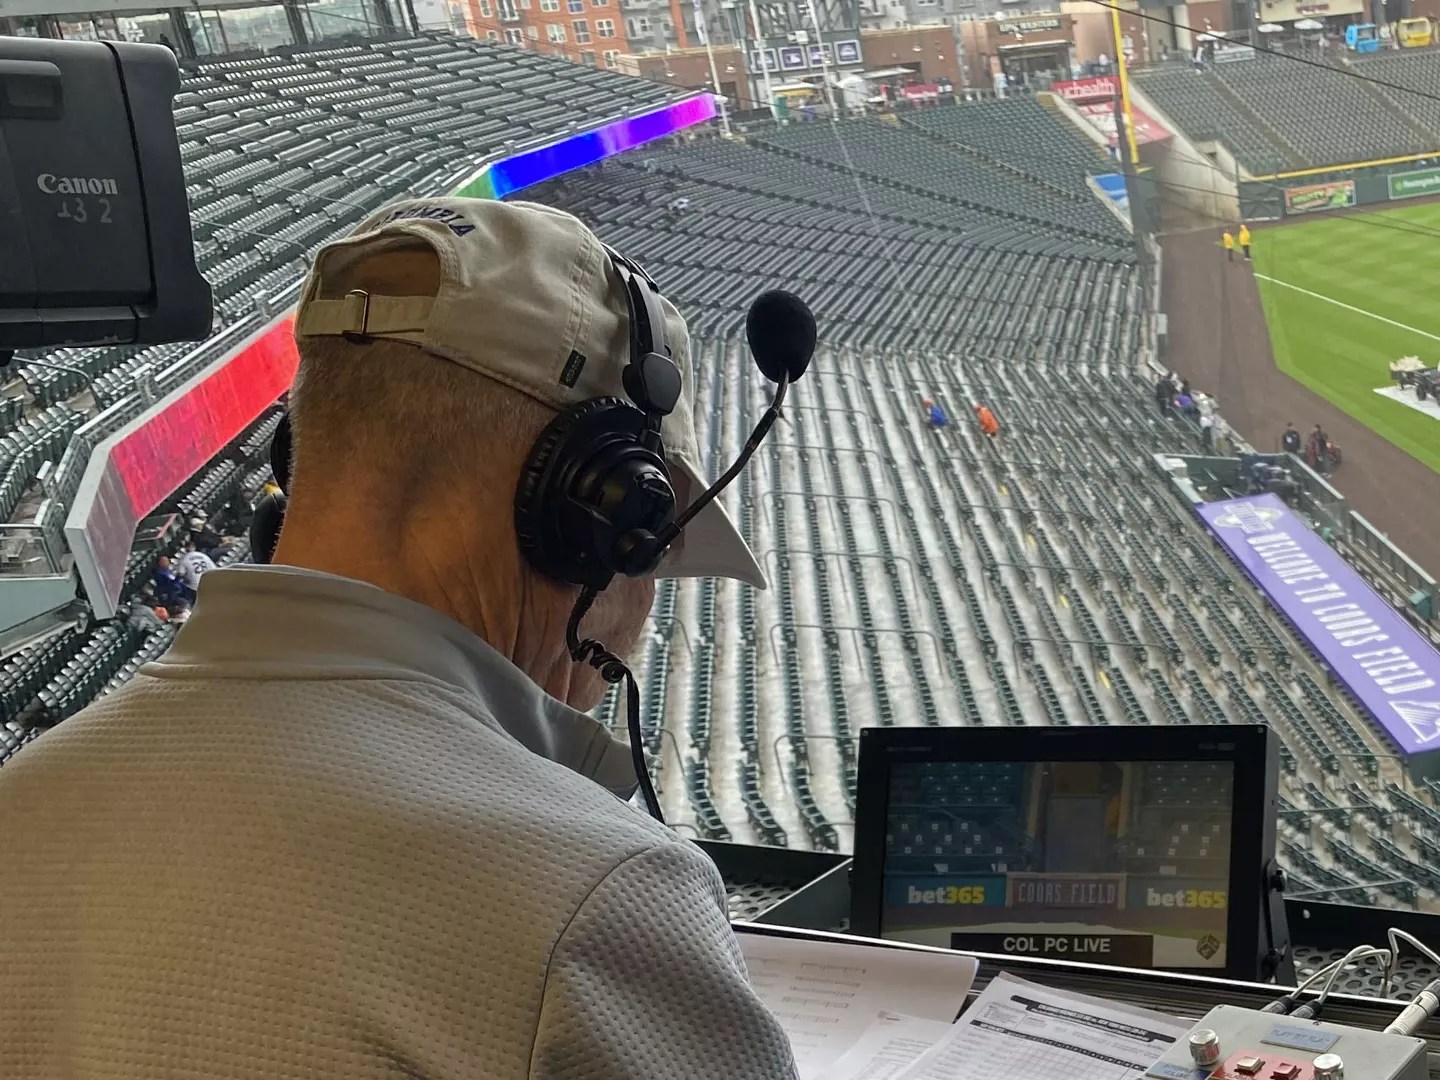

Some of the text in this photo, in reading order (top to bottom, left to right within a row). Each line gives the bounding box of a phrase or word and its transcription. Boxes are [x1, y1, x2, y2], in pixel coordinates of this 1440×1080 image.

[37, 173, 118, 195] Canon
[1247, 532, 1328, 585] WELCOME
[1294, 582, 1347, 603] TO
[1311, 603, 1390, 647] COORS
[1352, 646, 1436, 695] FIELD
[908, 885, 985, 905] bet365
[1018, 882, 1116, 905] COORS FIELD
[1147, 888, 1226, 909] bet365
[1003, 937, 1111, 953] COL PC LIVE
